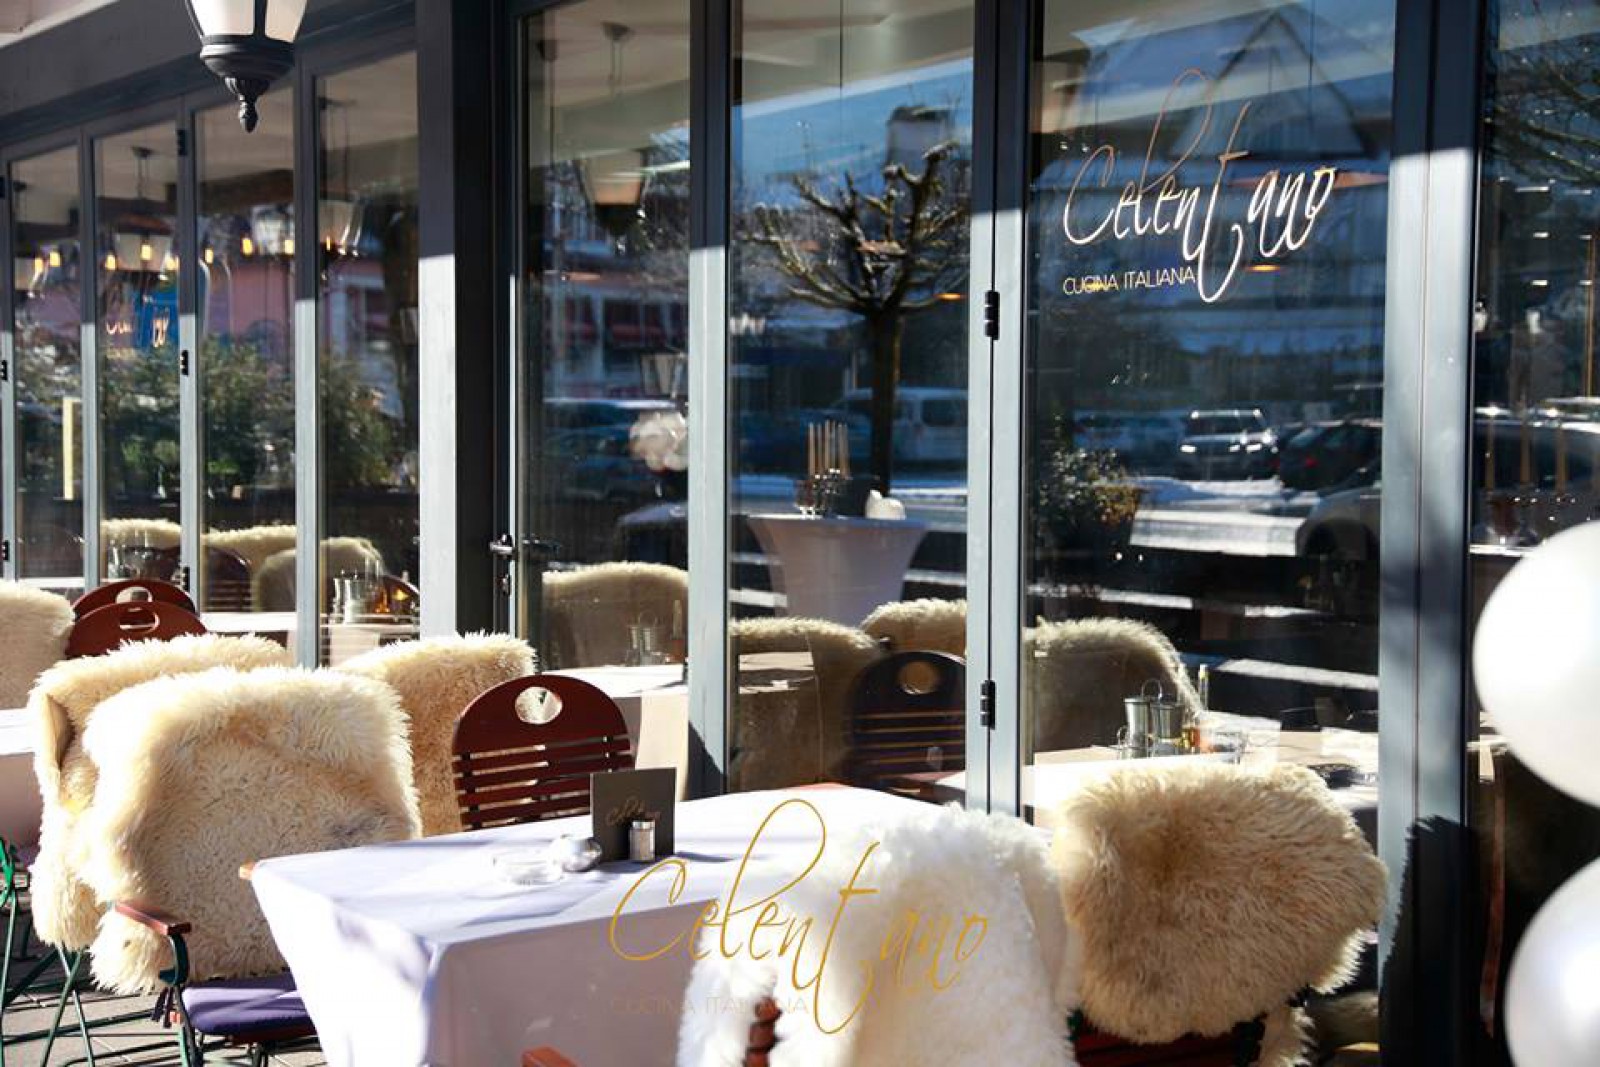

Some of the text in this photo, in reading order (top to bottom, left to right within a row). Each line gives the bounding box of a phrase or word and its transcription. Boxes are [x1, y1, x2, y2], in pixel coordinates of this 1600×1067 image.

[1062, 67, 1337, 303] Celentano
[1062, 266, 1197, 296] CUCINA ITALIANA
